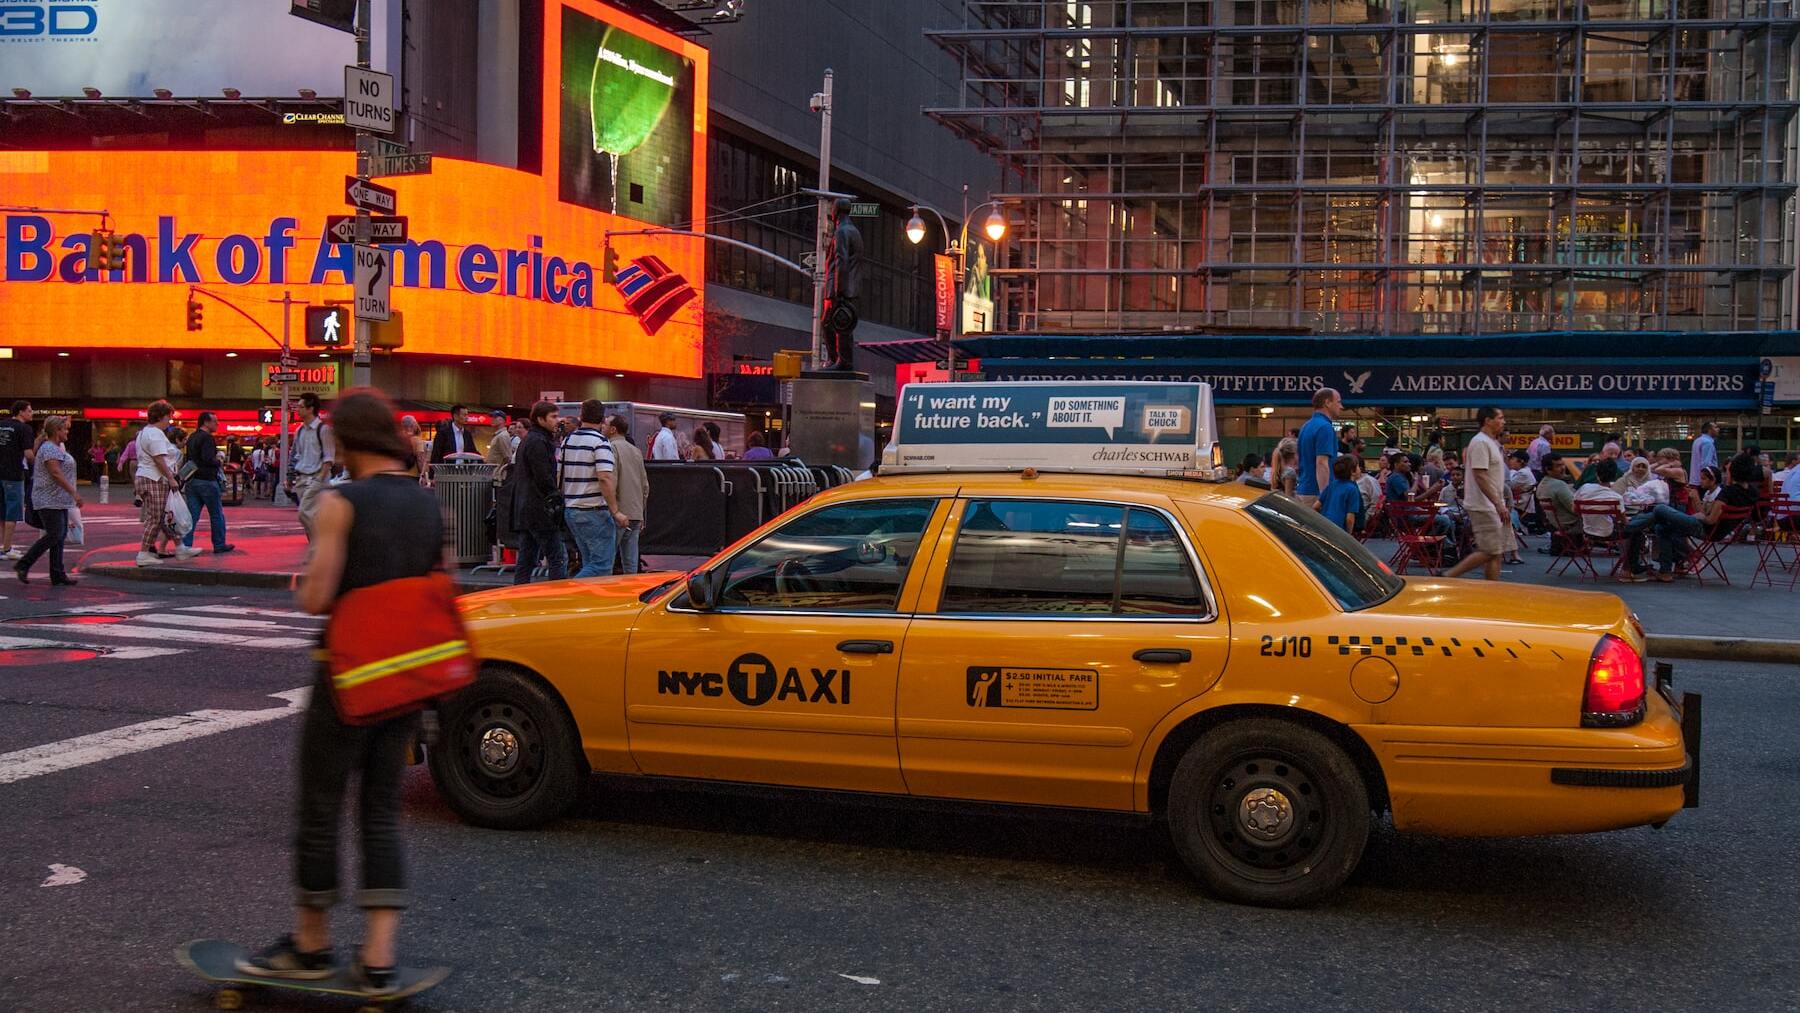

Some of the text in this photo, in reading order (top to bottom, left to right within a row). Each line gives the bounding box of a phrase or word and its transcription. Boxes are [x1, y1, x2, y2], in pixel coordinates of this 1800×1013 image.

[0, 6, 97, 35] 3D
[360, 79, 379, 97] NO
[348, 101, 391, 122] TURNS
[385, 156, 416, 174] TIMES
[353, 186, 390, 208] ONE WAY
[852, 205, 878, 214] ADWAY
[339, 224, 397, 235] ON WAY
[6, 216, 593, 307] Bank of America
[357, 250, 373, 268] NO
[938, 259, 947, 326] WELCOME
[360, 298, 385, 314] TURN
[740, 364, 774, 375] Marr
[1390, 374, 1744, 391] AMERICAN EAGLE OUTFITTERS
[930, 395, 976, 409] want
[982, 397, 1011, 412] my
[1054, 400, 1119, 410] DO SOMETHING
[914, 413, 970, 428] future
[1052, 412, 1092, 422] ABOUT IT.
[1148, 418, 1177, 426] CHUCK
[1092, 447, 1190, 462] charles SCHWAB
[1260, 634, 1312, 658] 2J10
[658, 660, 850, 704] NYC TAXI
[1006, 672, 1092, 682] $2.50 INITIAL FARE
